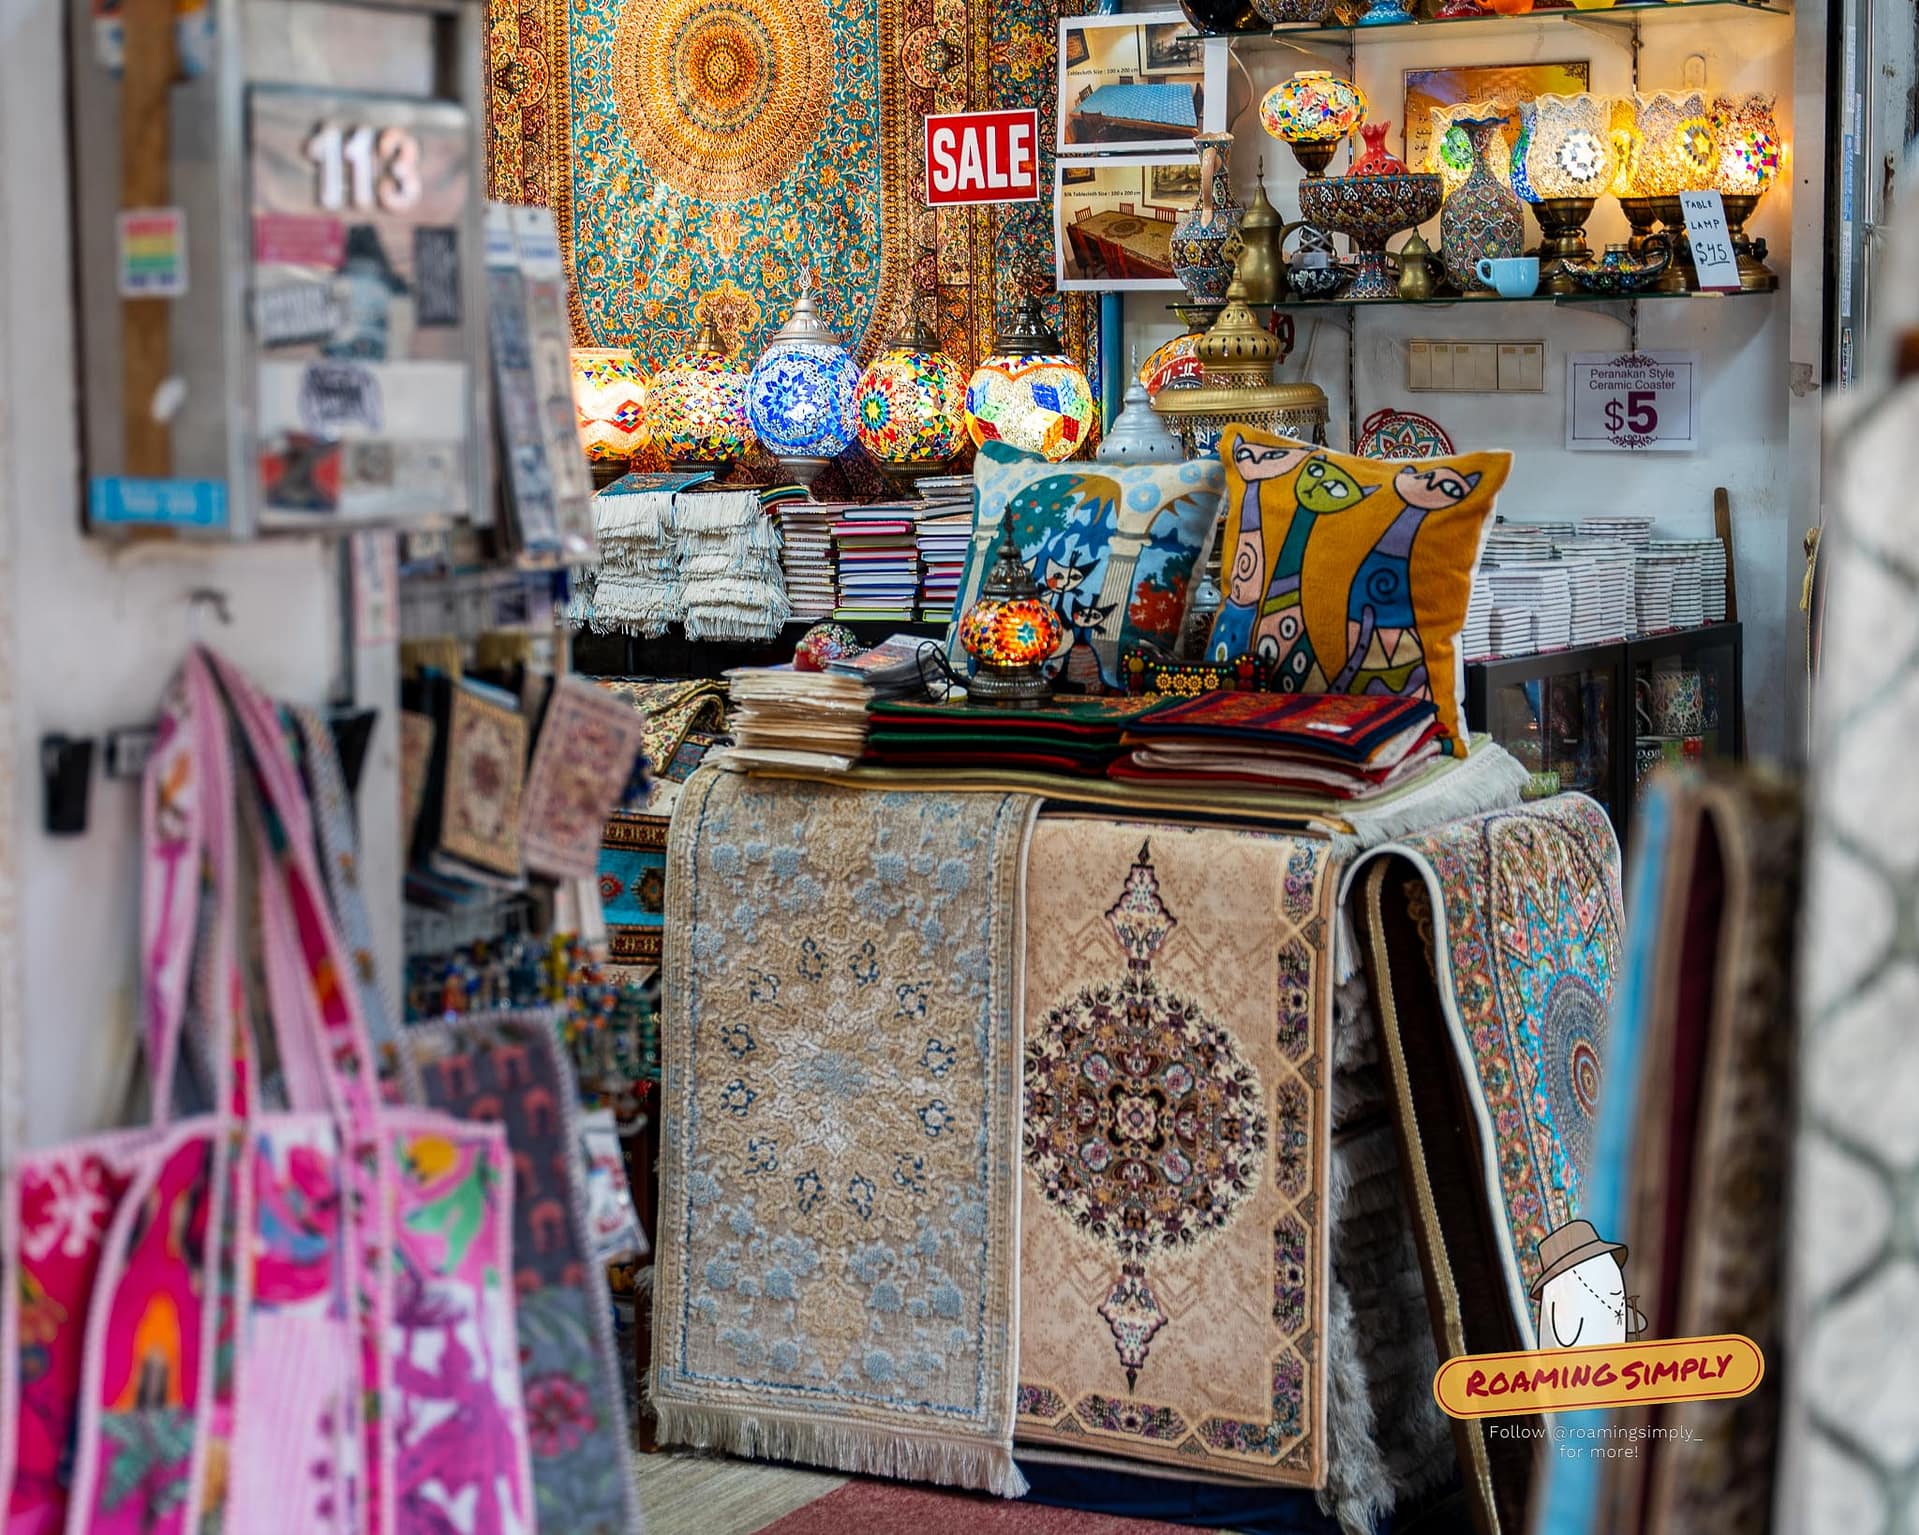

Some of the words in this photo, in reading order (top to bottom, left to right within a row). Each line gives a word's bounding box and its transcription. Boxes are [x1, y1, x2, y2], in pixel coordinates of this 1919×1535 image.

[306, 121, 421, 211] 113
[933, 124, 1031, 192] SALE
[1685, 200, 1713, 210] TABLE
[1690, 219, 1720, 230] LAMP
[1695, 242, 1727, 264] $45
[1590, 368, 1646, 379] Peranakan
[1649, 368, 1675, 380] Style
[1589, 380, 1632, 390] Ceramic
[1635, 380, 1676, 390] Coaster
[1604, 391, 1658, 435] $5
